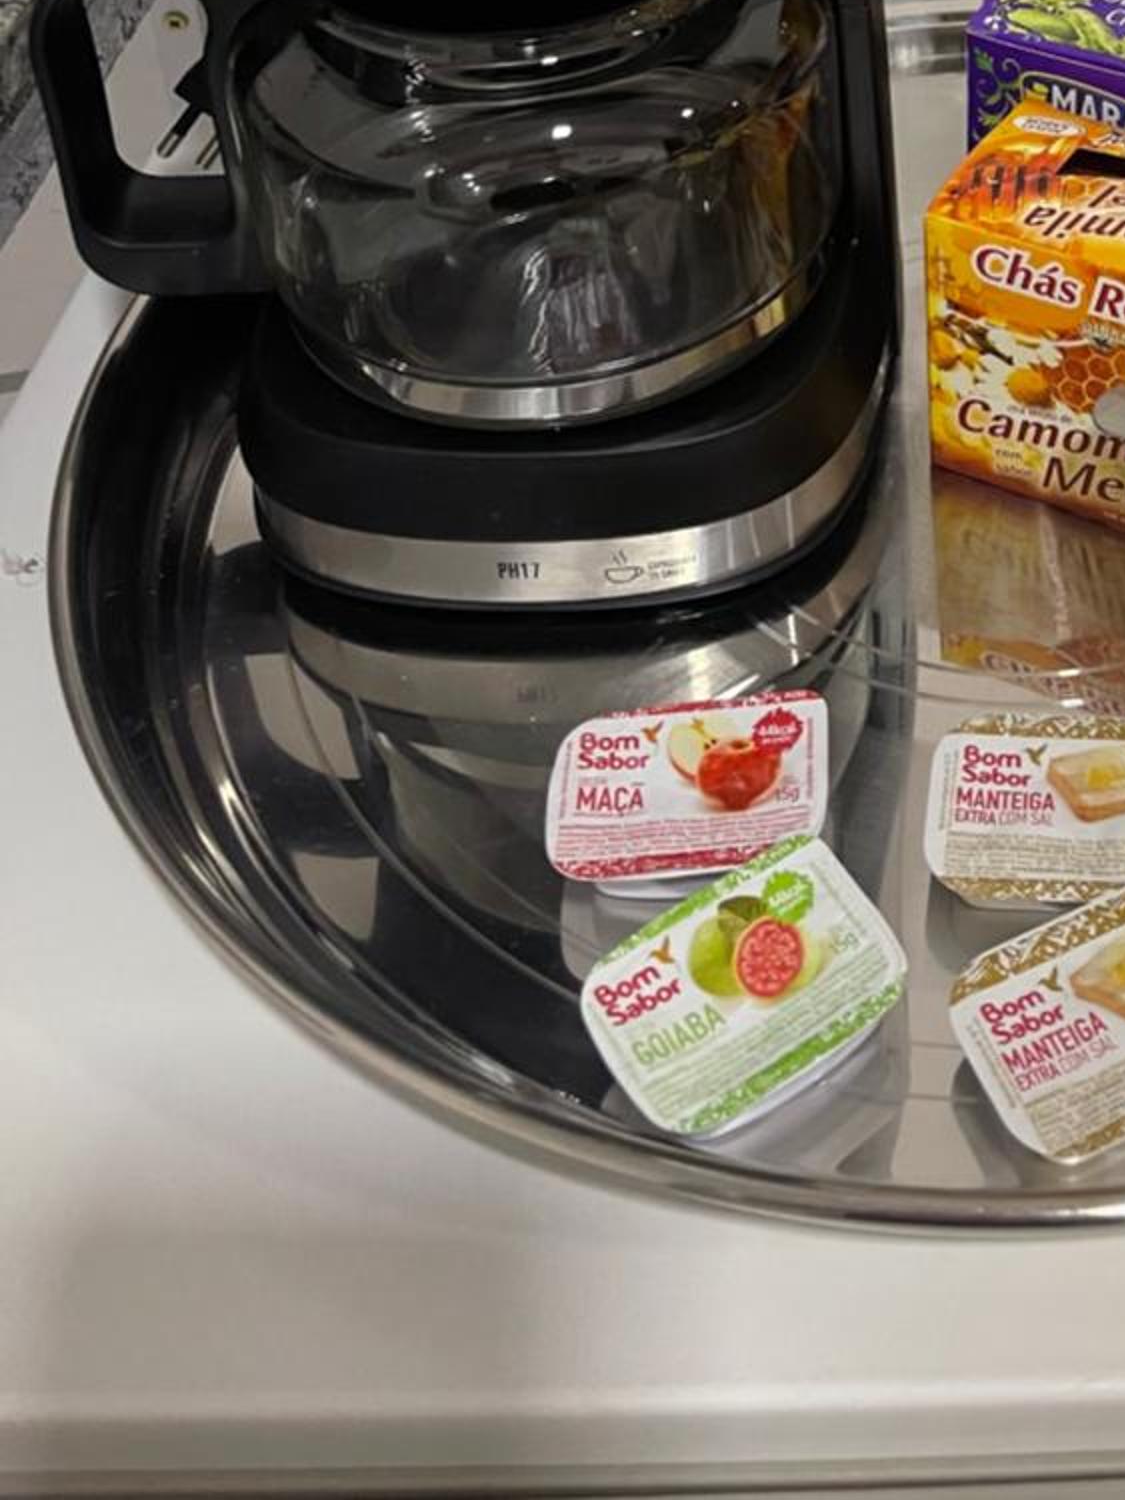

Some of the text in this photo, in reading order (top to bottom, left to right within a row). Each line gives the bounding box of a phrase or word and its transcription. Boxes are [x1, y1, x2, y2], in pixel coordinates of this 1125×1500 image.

[976, 248, 1079, 308] Chás
[497, 562, 541, 579] PH17
[579, 731, 641, 752] Bom
[963, 744, 1023, 768] Bom
[576, 752, 651, 771] Sabor
[961, 763, 1032, 788] Sabor
[575, 781, 645, 817] MAÇÃ
[956, 787, 1056, 813] MANTEIGA
[955, 809, 997, 826] EXTRA
[593, 964, 661, 1007] Bom
[604, 978, 683, 1028] Sabor
[980, 987, 1045, 1025] Bom
[631, 1002, 727, 1067] GOIABA
[990, 1004, 1065, 1045] Sabor
[1001, 1011, 1110, 1075] MANTEIGA
[1015, 1065, 1061, 1093] EXTRA
